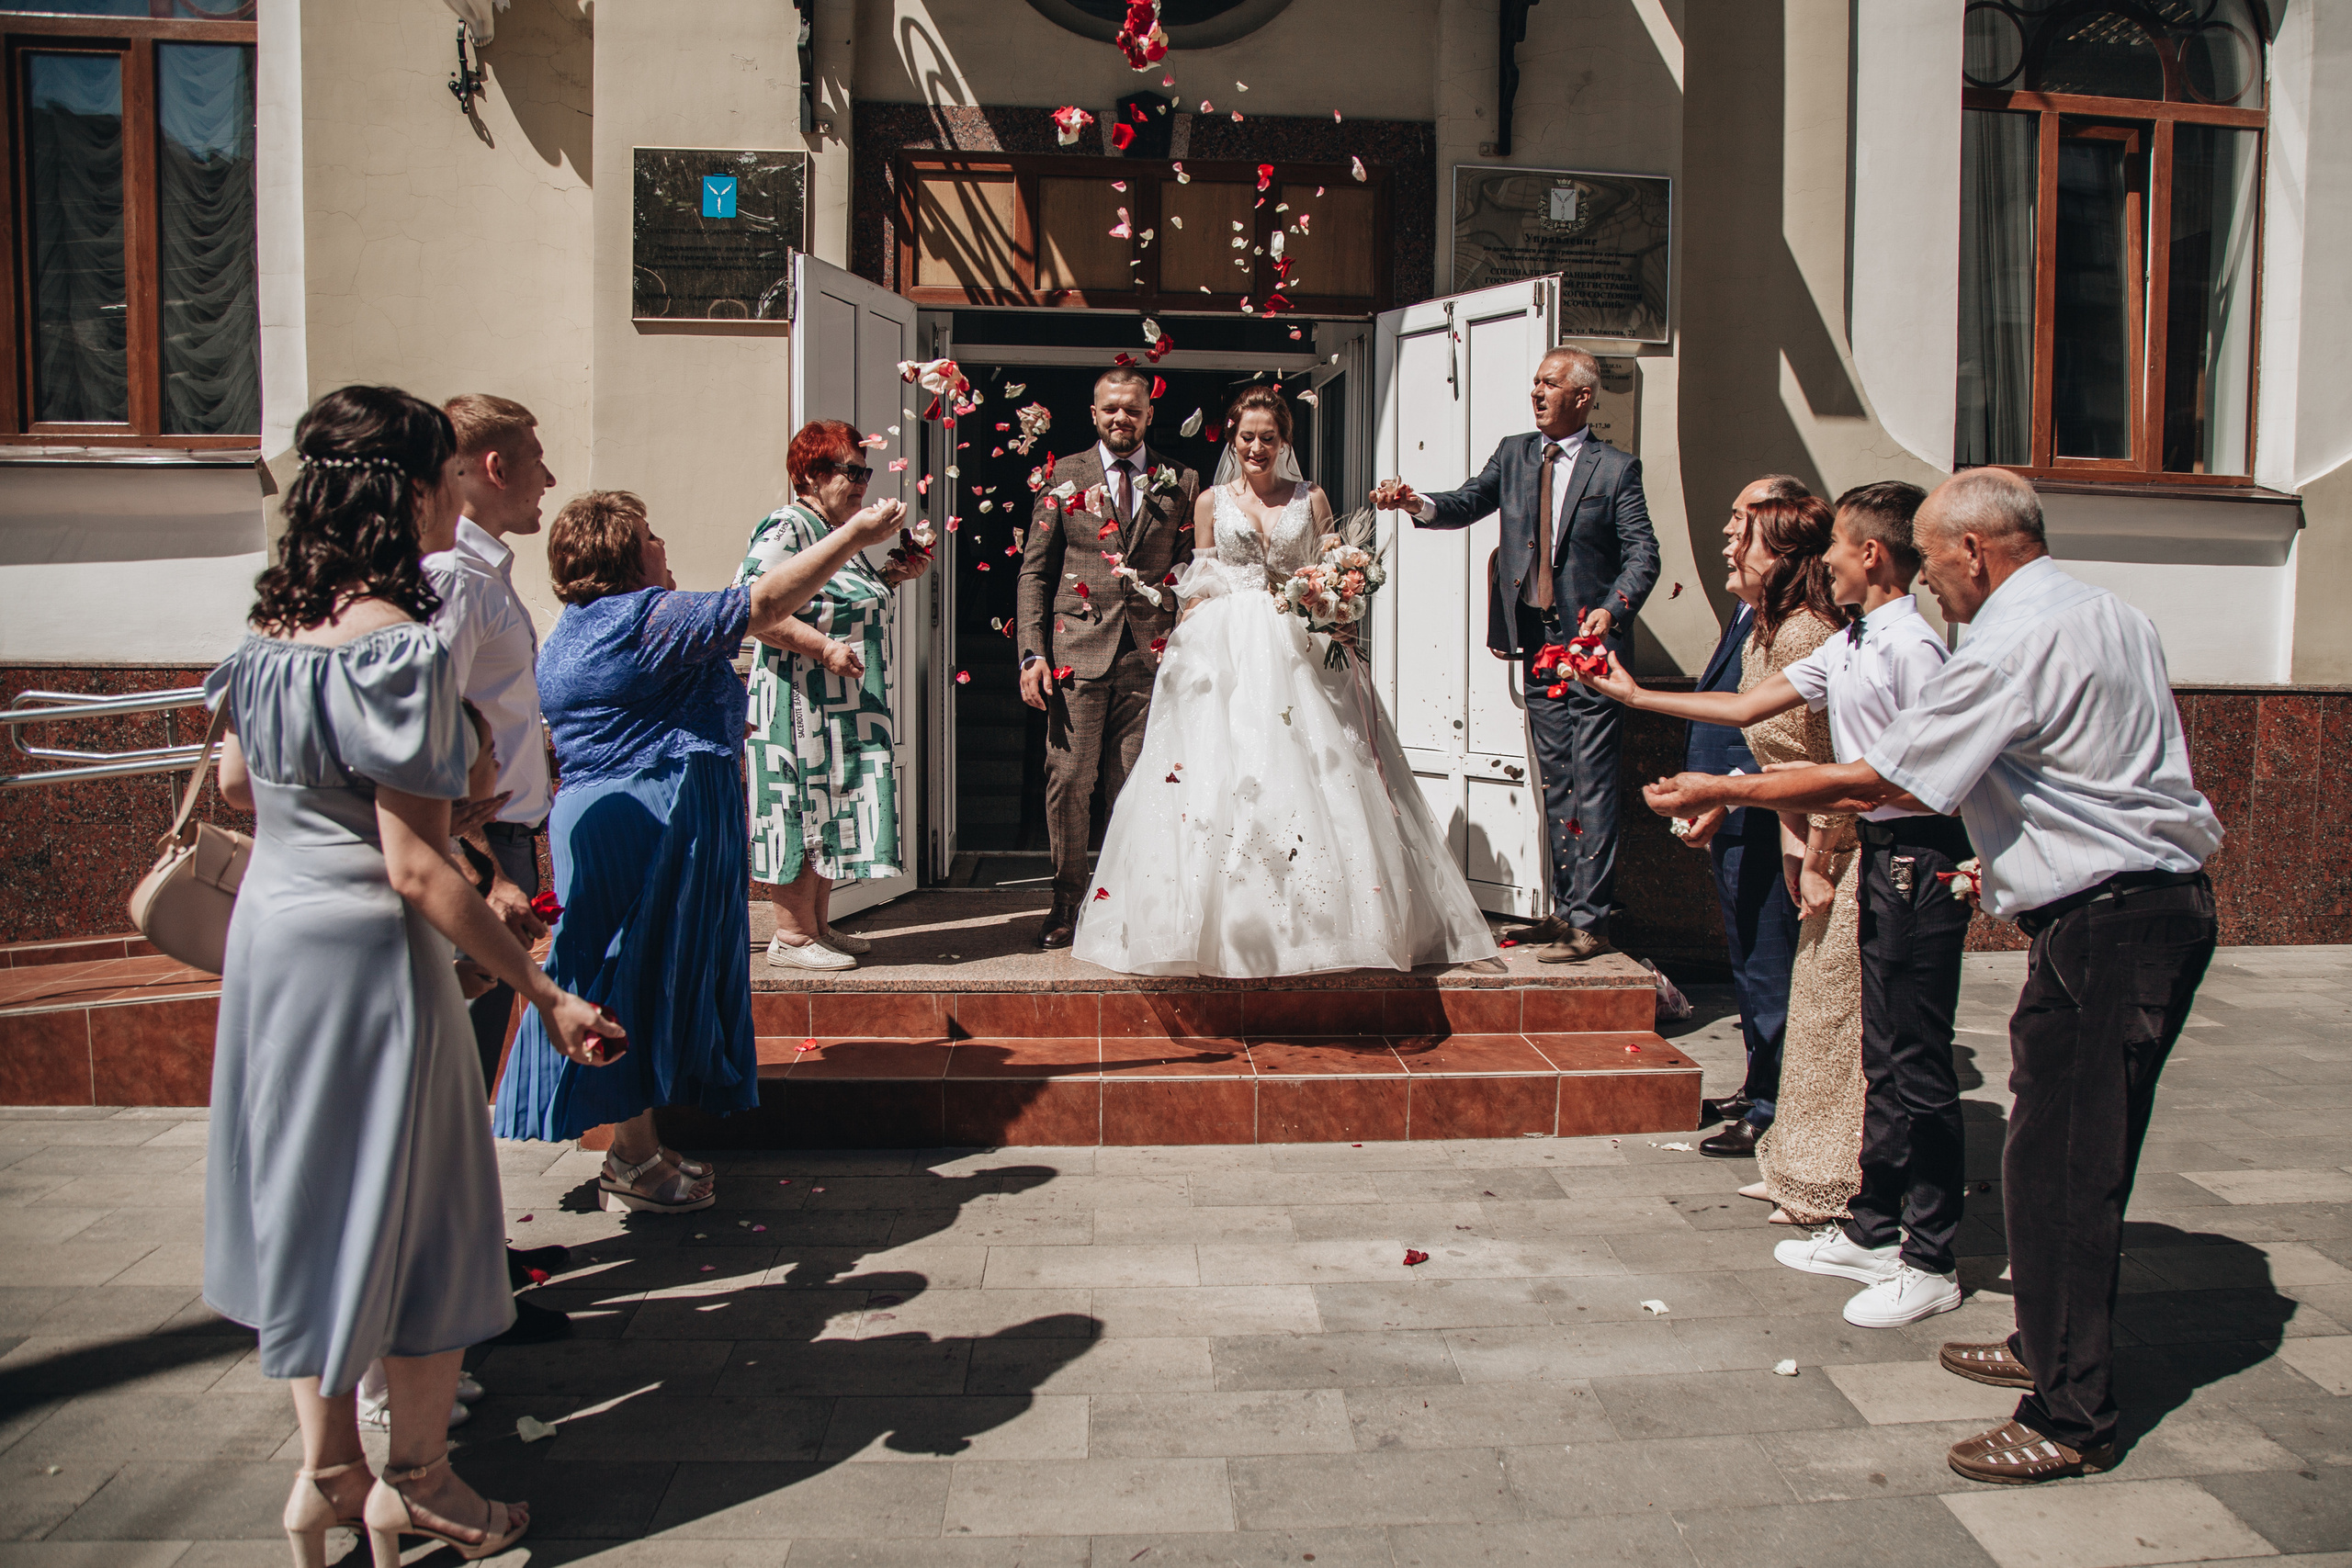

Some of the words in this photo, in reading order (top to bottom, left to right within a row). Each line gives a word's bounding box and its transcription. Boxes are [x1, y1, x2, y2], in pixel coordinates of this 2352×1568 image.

[1524, 233, 1599, 245] Управление
[1499, 254, 1550, 262] Правительства
[1603, 273, 1633, 282] ОТДЕЛ
[1576, 281, 1639, 291] РЕГИСТРАЦИИ
[1587, 291, 1643, 300] СОСТОЯНИЯ
[793, 690, 802, 706] JEANS
[796, 707, 806, 739] SACERDOTE
